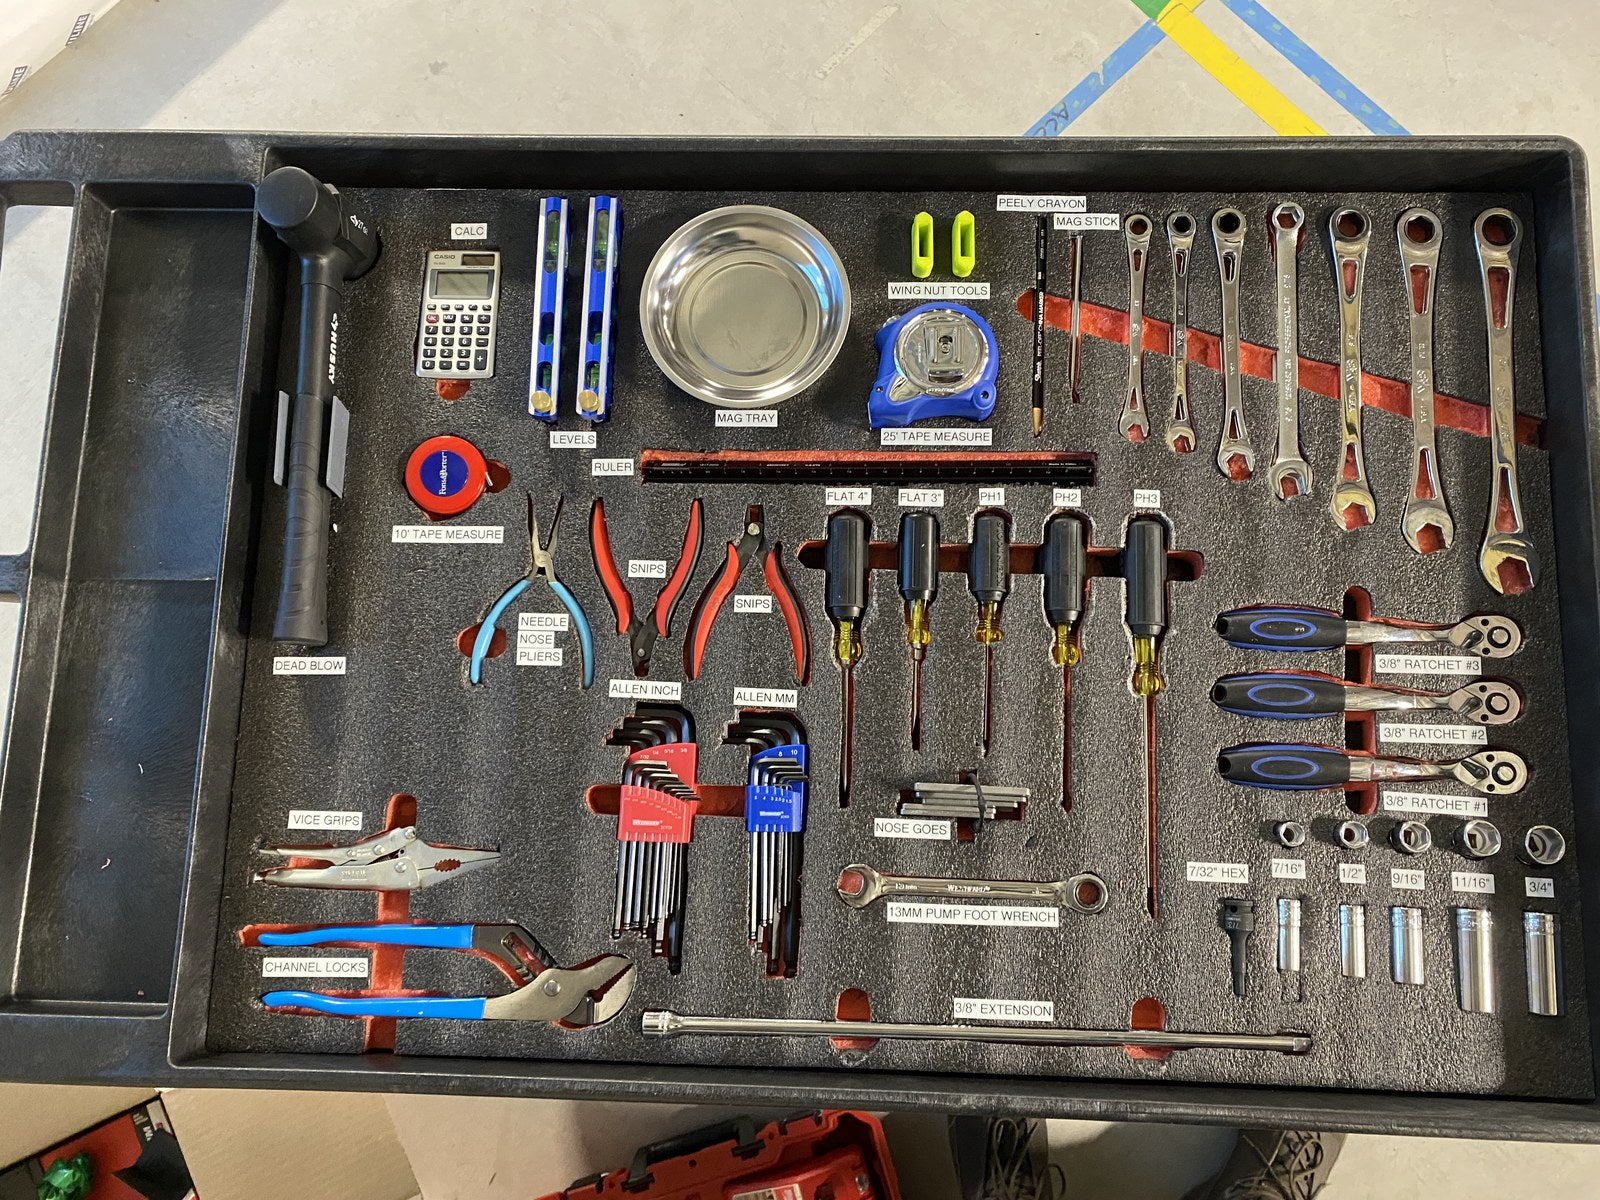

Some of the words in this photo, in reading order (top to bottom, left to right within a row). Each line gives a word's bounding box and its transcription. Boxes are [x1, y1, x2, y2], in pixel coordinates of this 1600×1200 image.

[998, 197, 1035, 208] PEELY
[1037, 198, 1086, 209] CRAYON
[1056, 216, 1082, 227] MAG
[1084, 216, 1118, 227] STICK
[454, 225, 485, 237] CALC
[890, 285, 922, 296] WING
[923, 285, 947, 296] NUT
[949, 285, 988, 296] TOOLS
[328, 330, 338, 385] HUSKY
[717, 413, 742, 424] MAG
[745, 413, 776, 425] TRAY
[552, 434, 596, 445] LEVELS
[882, 431, 899, 442] 25'
[900, 431, 931, 442] TAPE
[933, 431, 991, 442] MEASURE
[594, 462, 632, 472] RULER
[826, 491, 854, 501] FLAT
[857, 491, 869, 501] 4"
[899, 492, 927, 503] FLAT
[930, 493, 942, 503] 3"
[980, 491, 1001, 502] PH1
[1054, 492, 1078, 503] PH2
[1135, 492, 1158, 504] PH3
[395, 528, 410, 539] 10'
[412, 529, 443, 540] TAPE
[445, 529, 502, 540] MEASURE
[629, 563, 666, 574] SNIPS
[735, 598, 771, 609] SNIPS
[520, 616, 567, 627] NEEDLE
[519, 633, 553, 645] NOSE
[519, 651, 561, 662] PLIERS
[274, 660, 306, 671] DEAD
[309, 660, 344, 671] BLOW
[1378, 658, 1401, 669] 3/8"
[1404, 658, 1463, 671] RATCHET
[1466, 660, 1480, 671] #3
[610, 683, 649, 695] ALLEN
[651, 685, 680, 696] INCH
[735, 691, 772, 703] ALLEN
[775, 693, 795, 704] MM
[1383, 727, 1406, 739] 3/8"
[1409, 727, 1468, 740] RATCHET
[1471, 729, 1485, 741] #2
[1386, 795, 1409, 807] 3/8"
[1411, 798, 1471, 811] RATCHET
[1473, 801, 1487, 812] #1
[293, 814, 321, 826] VICE
[323, 814, 360, 827] GRIPS
[875, 822, 910, 834] NOSE
[912, 823, 948, 836] GOES
[1188, 865, 1218, 878] 7/32"
[1221, 867, 1246, 879] HEX
[1273, 861, 1303, 875] 7/16"
[1341, 867, 1363, 879] 1/2"
[1392, 872, 1422, 886] 9/16"
[1454, 876, 1490, 888] 11/16"
[1529, 882, 1552, 893] 3/4"
[889, 906, 922, 918] 13MM
[925, 907, 961, 920] PUMP
[964, 909, 999, 921] FOOT
[1000, 910, 1056, 923] WRENCH
[264, 961, 322, 973] CHANNEL
[325, 961, 367, 973] LOCKS
[955, 1002, 977, 1014] 3/8"
[979, 1004, 1053, 1016] EXTENSION
